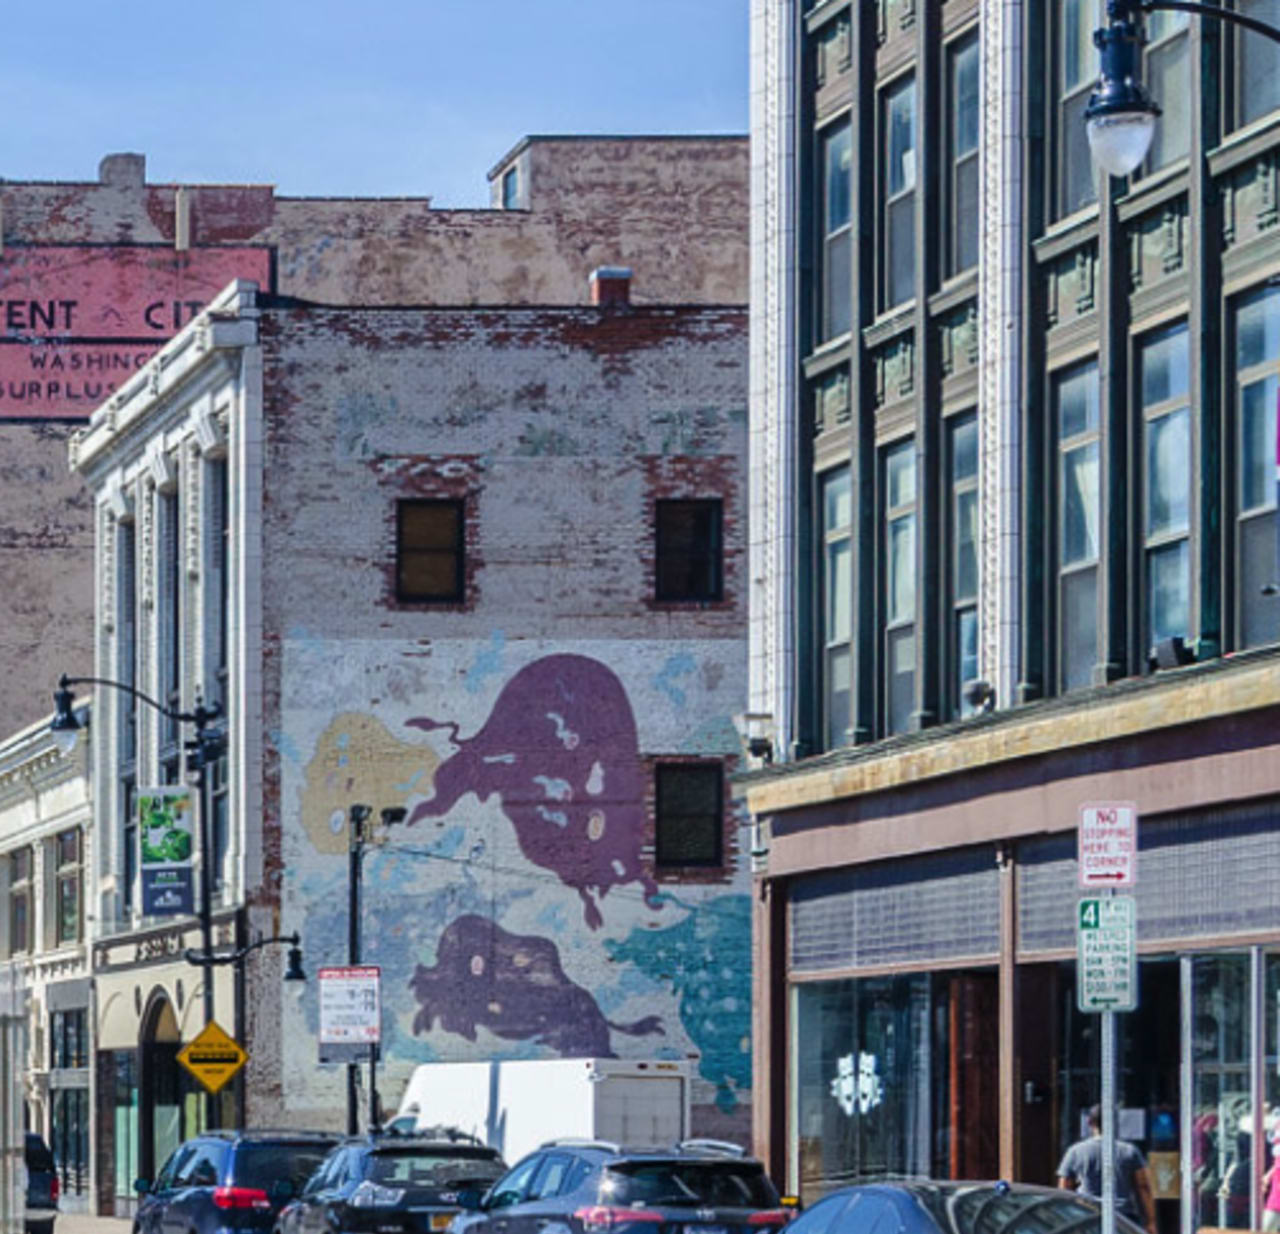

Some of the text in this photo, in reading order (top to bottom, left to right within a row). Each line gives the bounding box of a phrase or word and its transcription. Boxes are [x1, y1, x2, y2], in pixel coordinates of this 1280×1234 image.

[144, 301, 204, 330] CIT
[30, 352, 155, 371] WASHING
[1096, 809, 1118, 825] NO
[1083, 841, 1132, 854] HERE TO
[1085, 856, 1129, 869] CORNER
[1083, 903, 1096, 927] 4
